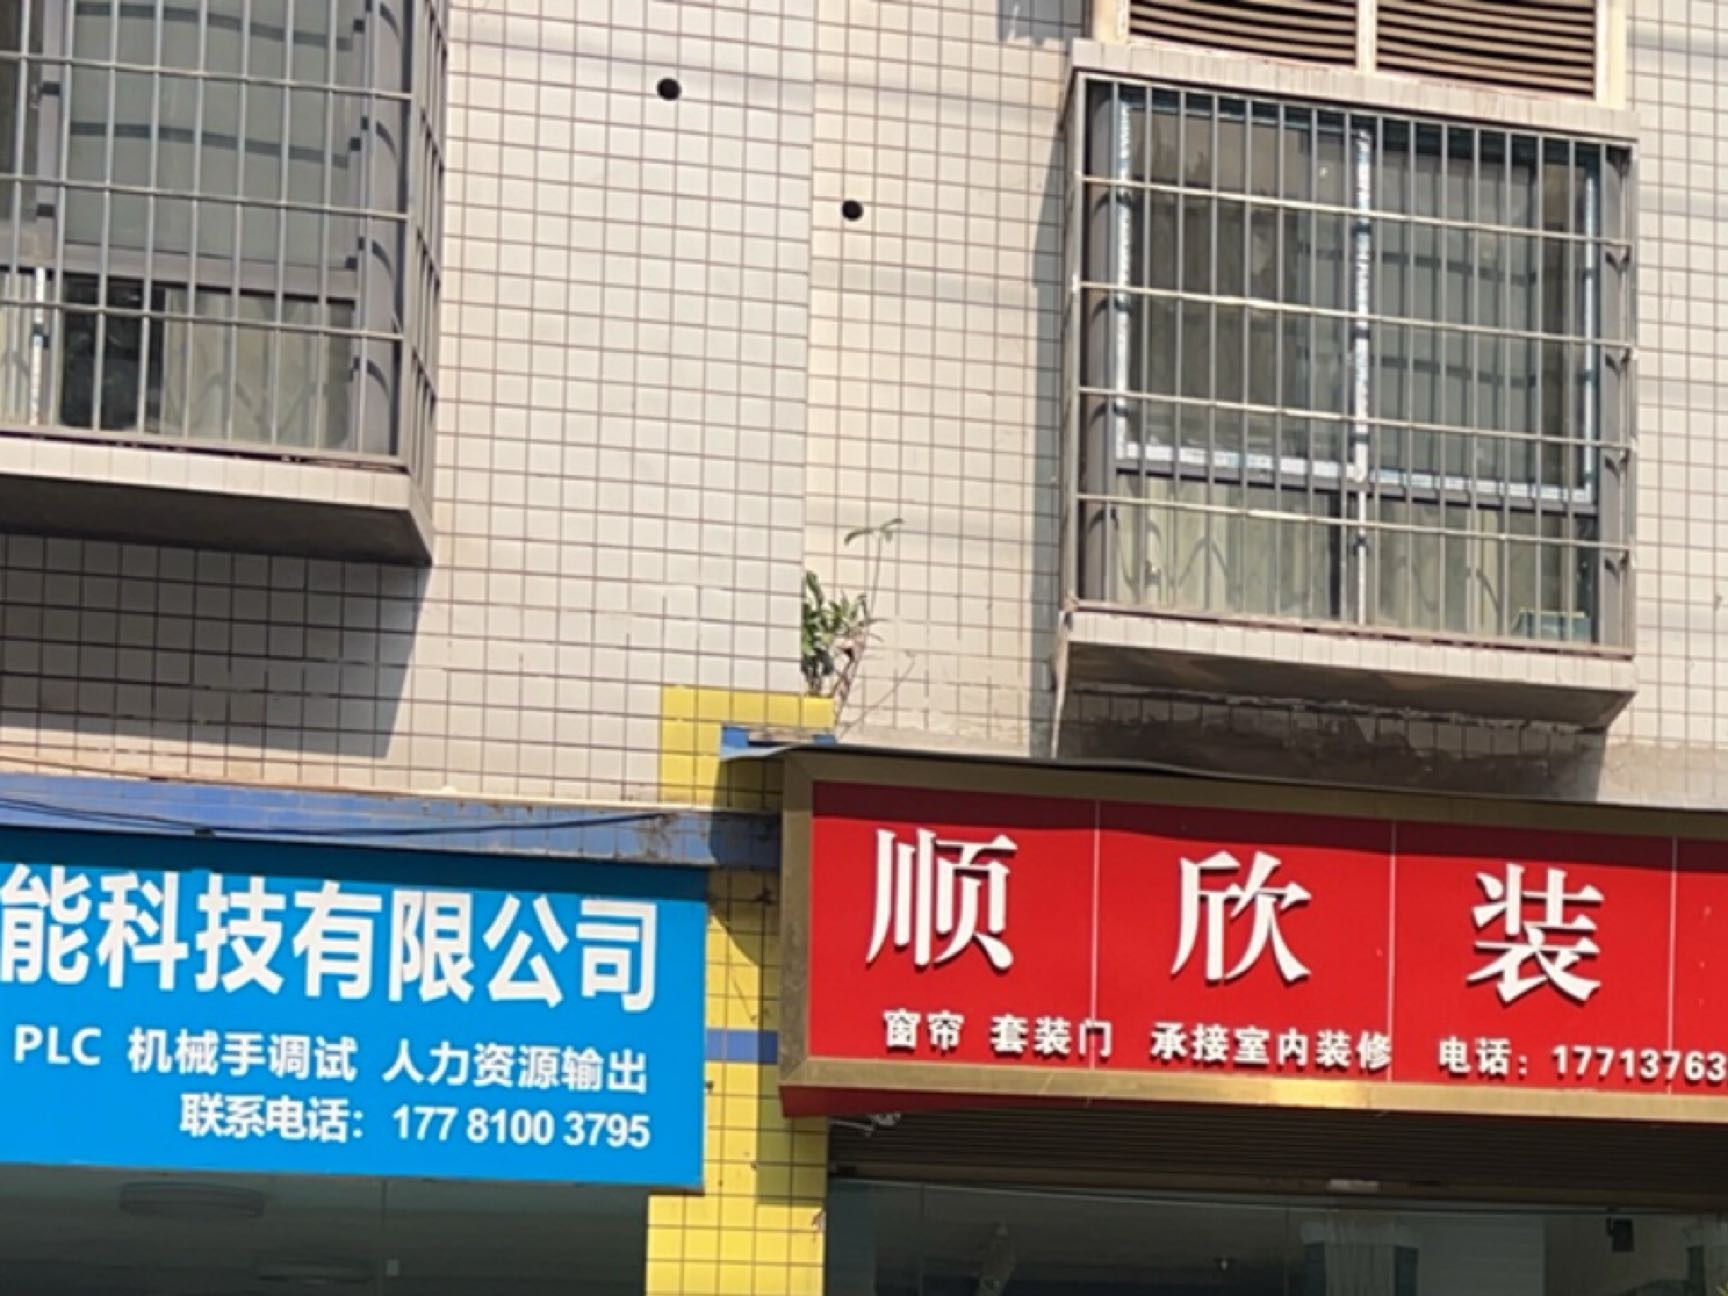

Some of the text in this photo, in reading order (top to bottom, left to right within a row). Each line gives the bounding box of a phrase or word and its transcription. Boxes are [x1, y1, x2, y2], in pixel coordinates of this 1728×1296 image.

[0, 863, 658, 1011] 能科技有限公司
[14, 1024, 648, 1094] PLC 机械手调试 人力资源输出
[883, 1008, 965, 1051] 窗帘
[989, 1014, 1113, 1058] 套装门
[1150, 1021, 1392, 1071] 承接室内装修
[393, 1105, 457, 1141] 177
[466, 1108, 555, 1145] 8100
[564, 1111, 651, 1149] 3795
